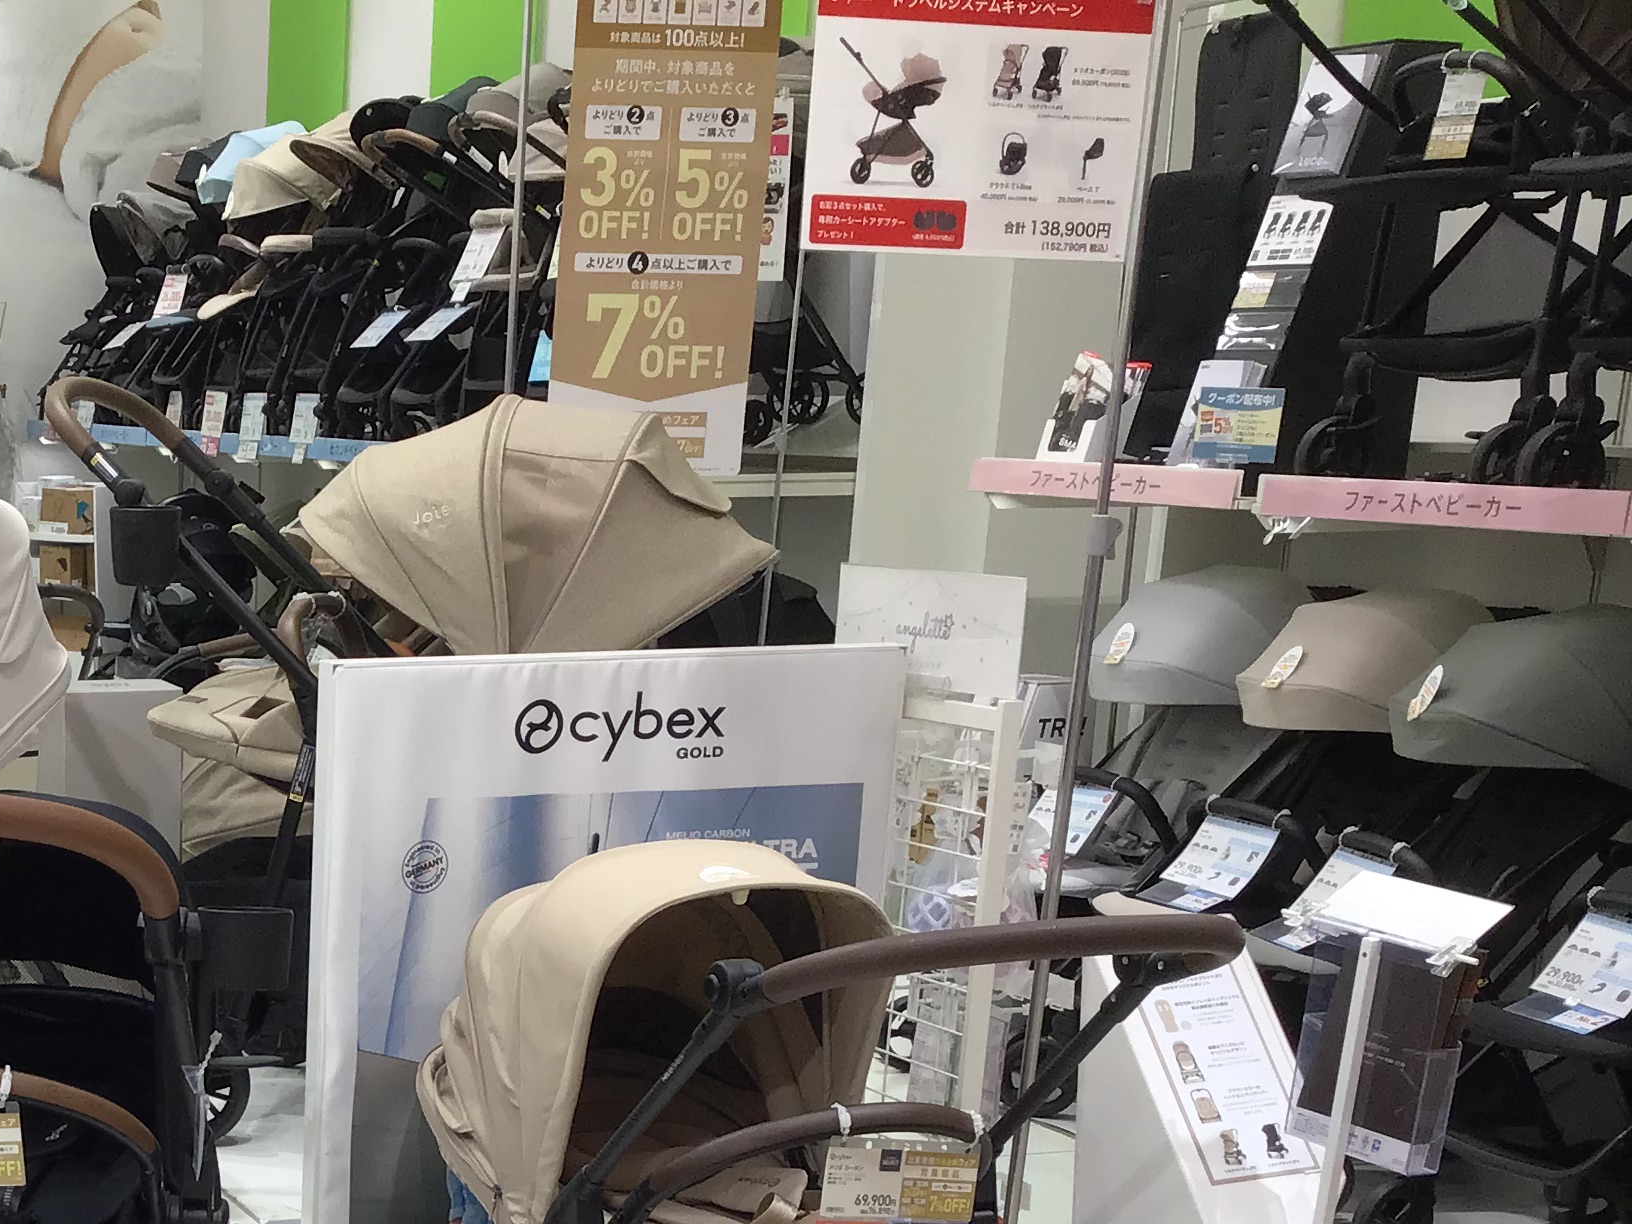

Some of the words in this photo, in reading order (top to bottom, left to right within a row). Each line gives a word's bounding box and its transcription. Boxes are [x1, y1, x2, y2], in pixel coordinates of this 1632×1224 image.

[591, 78, 756, 96] よりどりでご購入いただくと
[578, 210, 650, 240] OFF!
[672, 212, 743, 242] OFF!
[1031, 219, 1111, 240] 138,900円
[640, 344, 725, 380] OFF!
[1030, 470, 1161, 494] ファーストーカー
[1344, 491, 1522, 518] ファーストベビーカー
[569, 691, 727, 762] cybex
[676, 745, 724, 760] GOLD
[704, 828, 750, 839] CARBON
[404, 856, 444, 878] GERMANY
